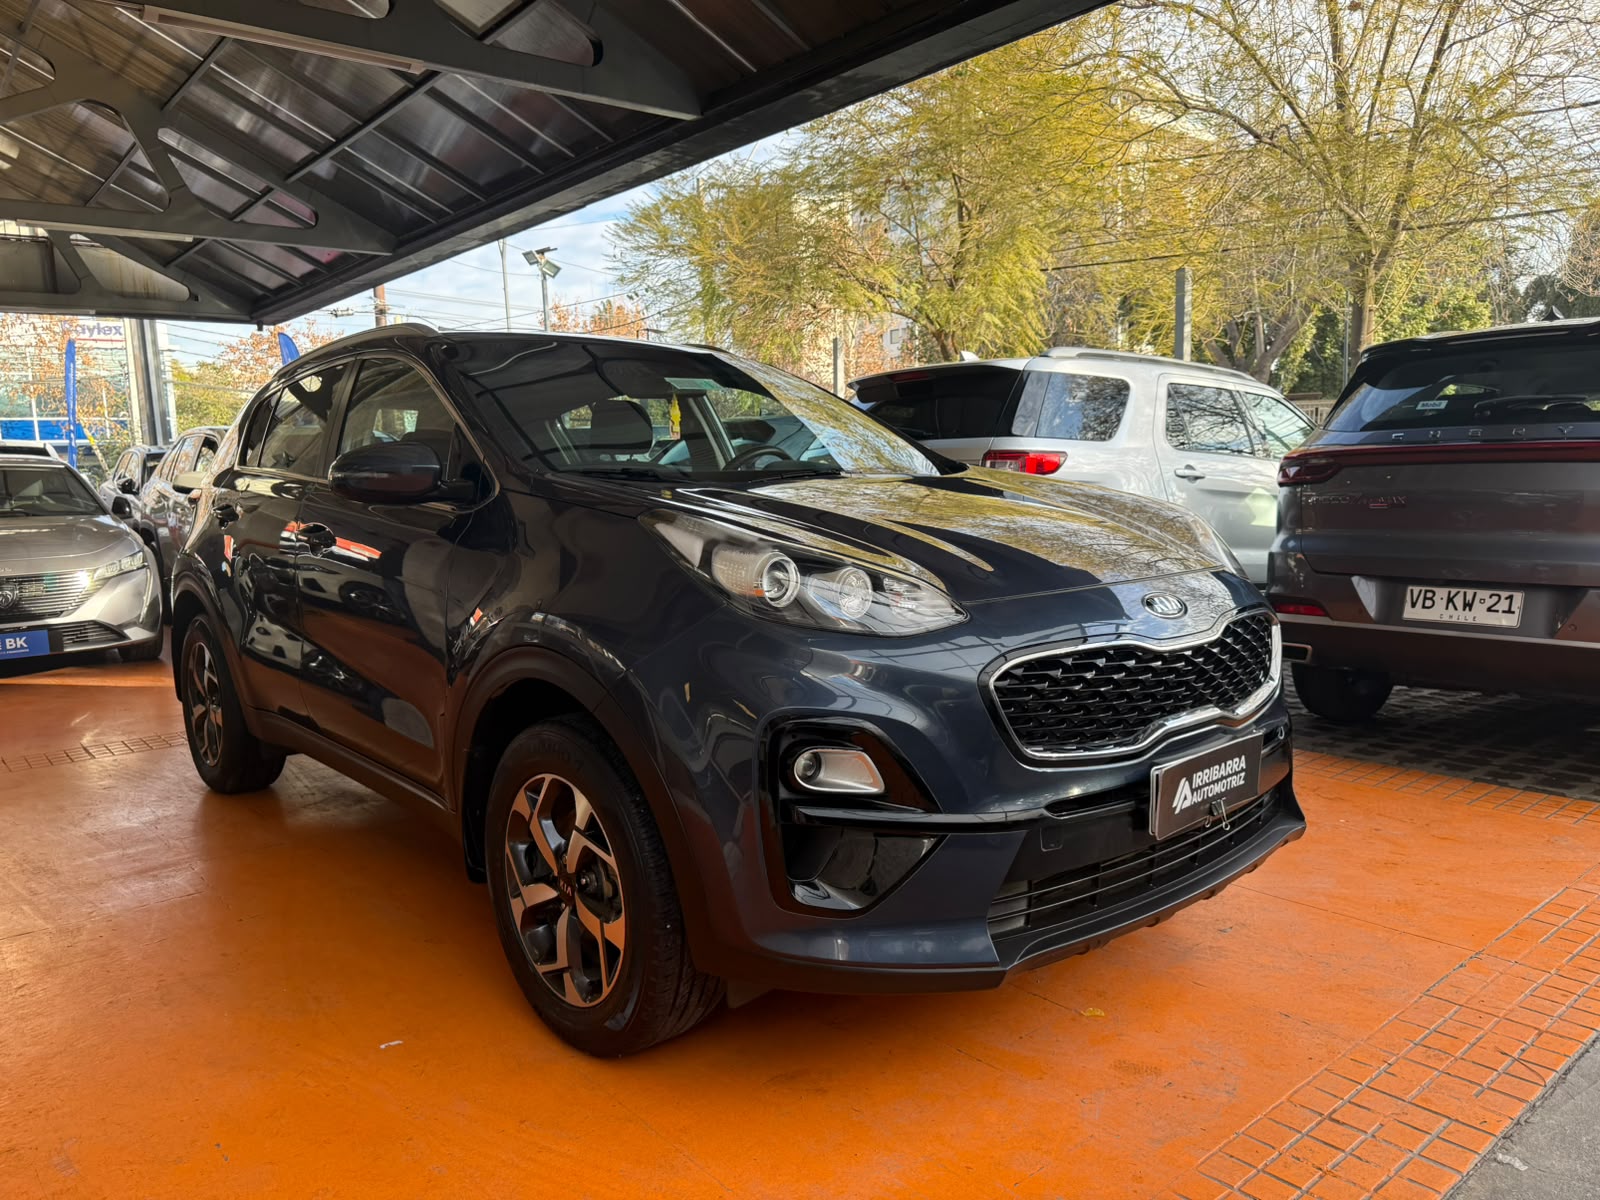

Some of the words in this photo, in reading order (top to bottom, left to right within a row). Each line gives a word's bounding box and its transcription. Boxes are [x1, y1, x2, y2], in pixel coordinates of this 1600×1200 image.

[1440, 613, 1477, 622] CHILE
[5, 636, 29, 650] BK
[1192, 754, 1247, 789] IRRIBARRA
[1191, 771, 1246, 805] AUTOMOTRIZ
